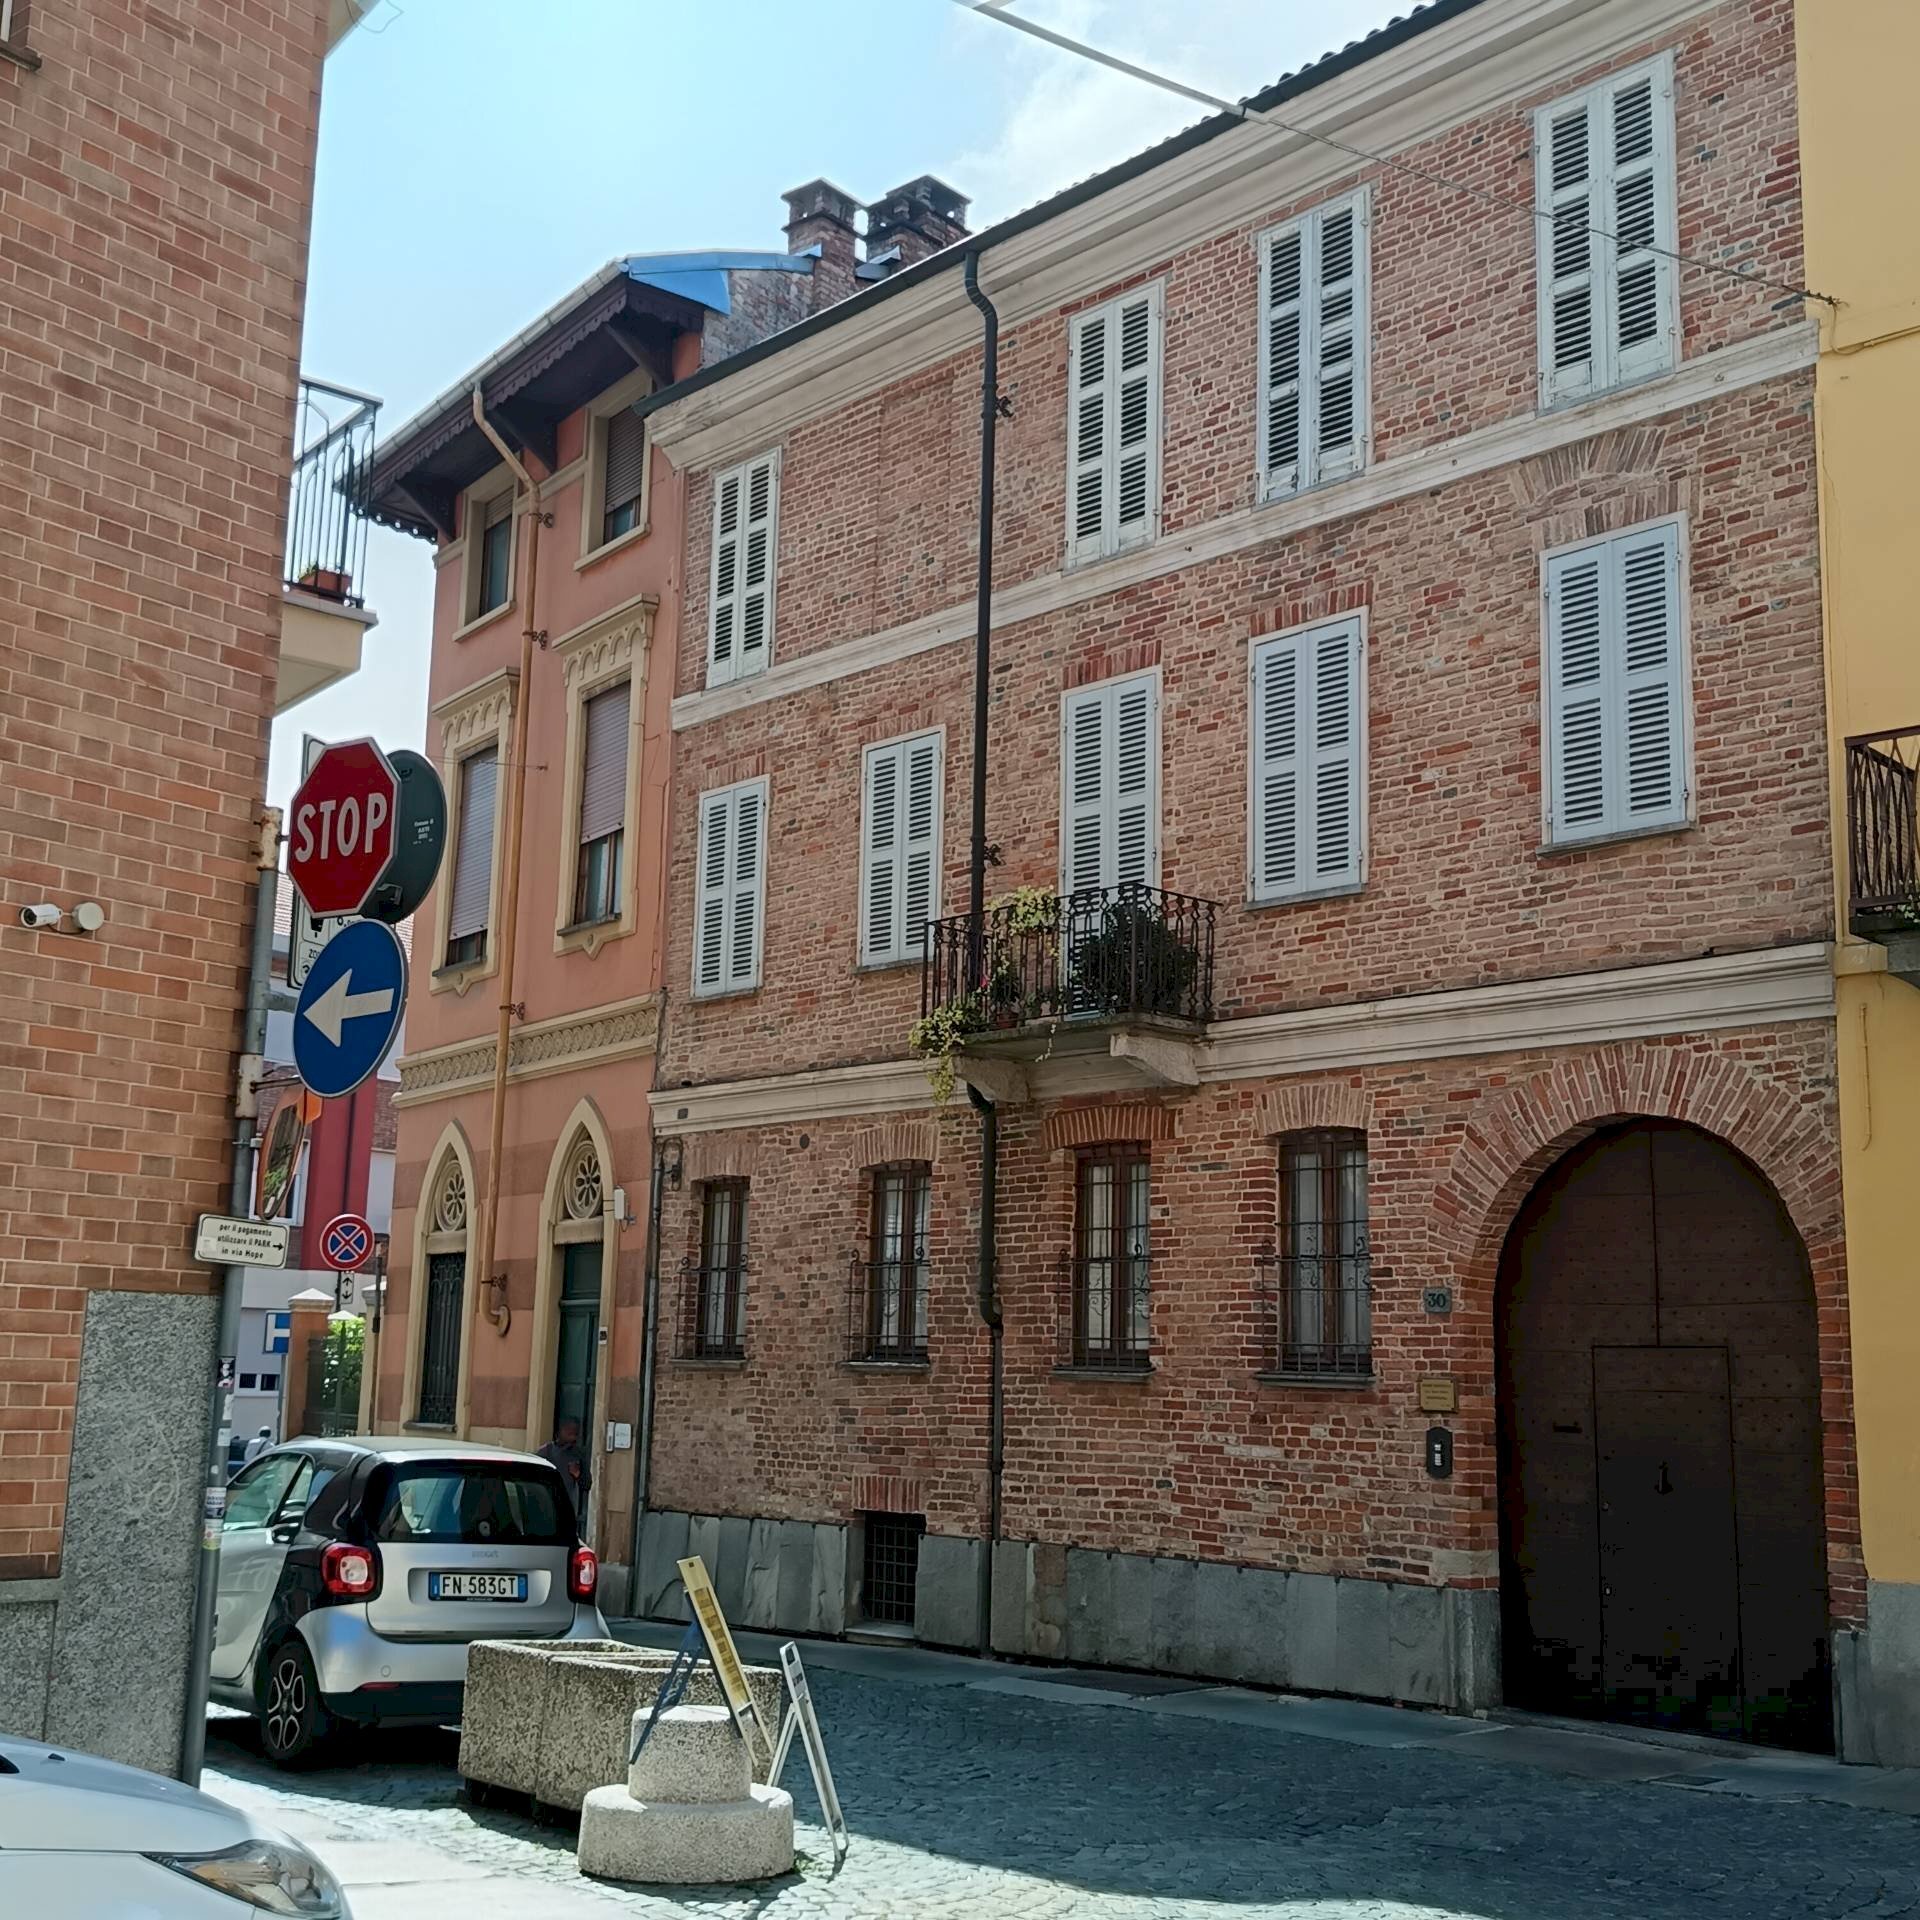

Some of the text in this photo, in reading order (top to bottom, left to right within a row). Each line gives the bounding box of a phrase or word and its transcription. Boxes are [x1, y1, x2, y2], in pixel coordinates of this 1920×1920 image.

[294, 792, 388, 863] STOP
[238, 1225, 272, 1236] pagamento
[217, 1235, 271, 1248] utilizzare il PARK
[231, 1248, 243, 1256] via
[245, 1250, 264, 1259] Hope
[1428, 1292, 1446, 1308] 30
[442, 1576, 517, 1595] FN 583GT
